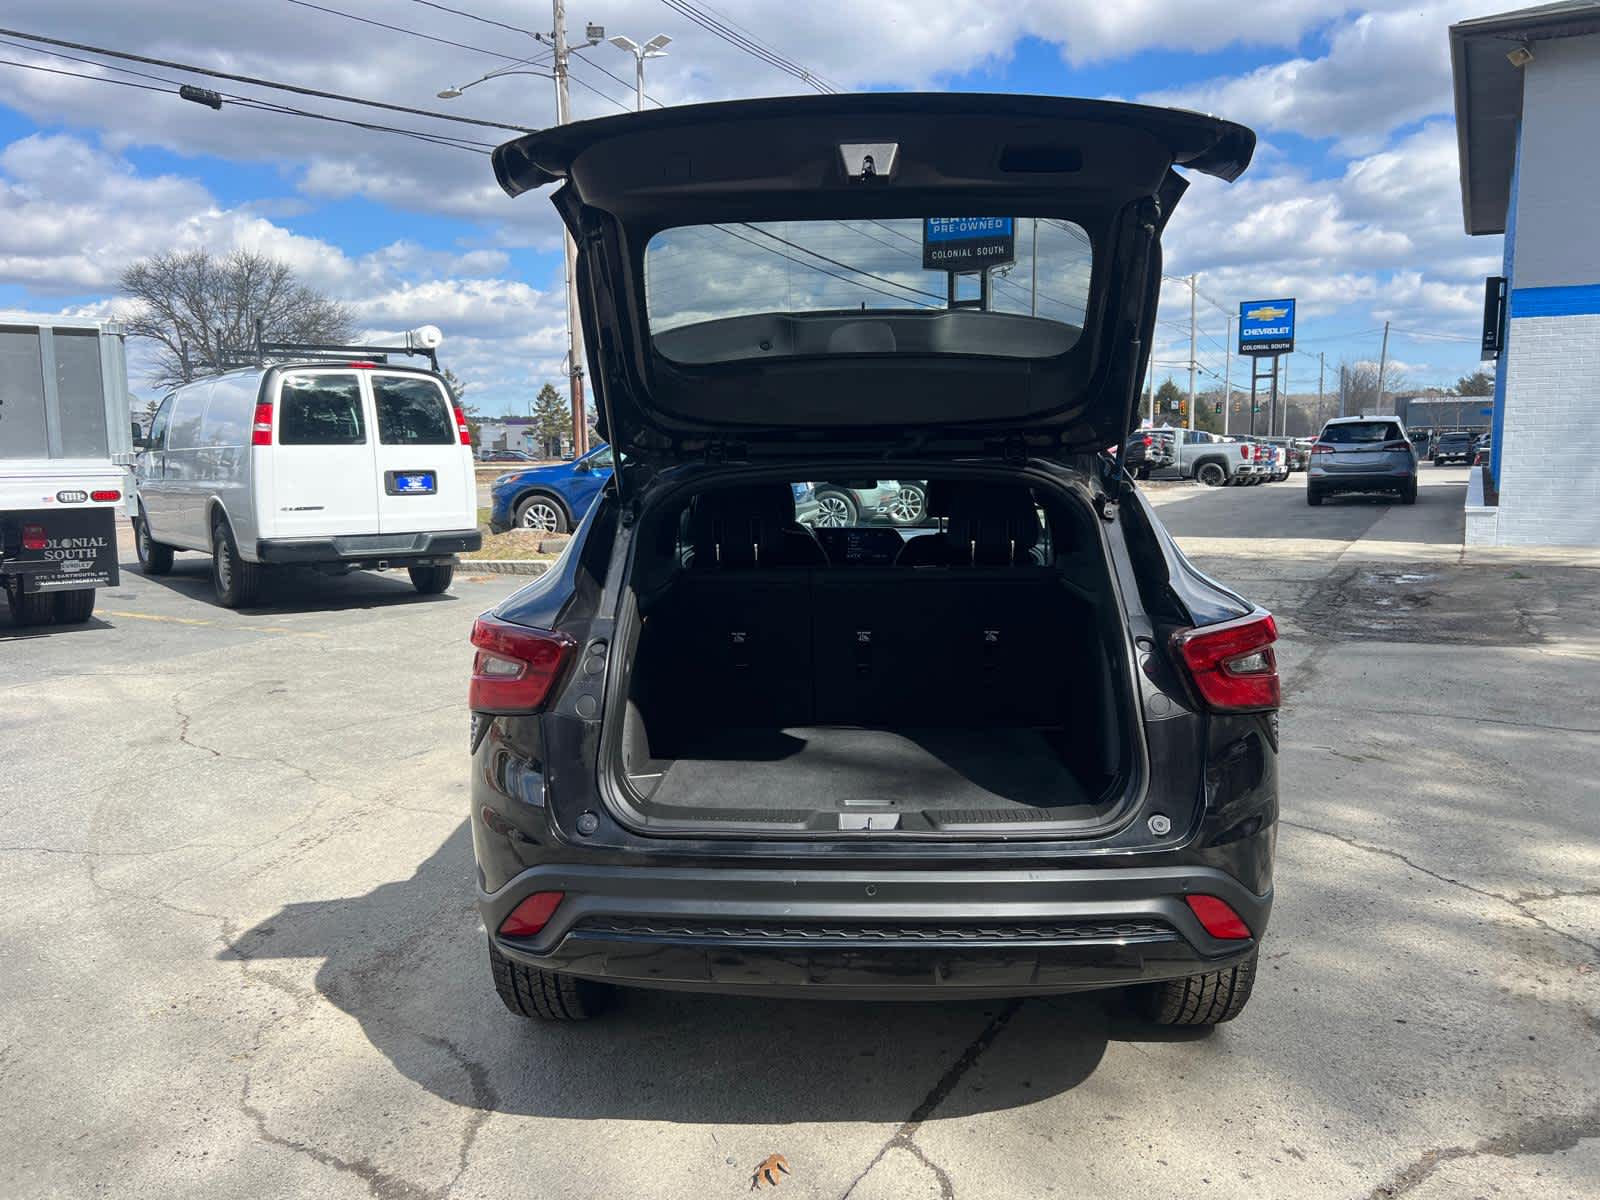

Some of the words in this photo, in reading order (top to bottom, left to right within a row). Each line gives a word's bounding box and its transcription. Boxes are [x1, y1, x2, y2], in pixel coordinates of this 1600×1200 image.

[933, 220, 1002, 233] PRE-OWNED
[931, 250, 972, 259] COLONIAL
[977, 246, 1004, 256] SOUTH
[1243, 327, 1290, 336] CHEVROLET
[1242, 343, 1269, 351] COLONIAL
[44, 549, 97, 560] SOUTH
